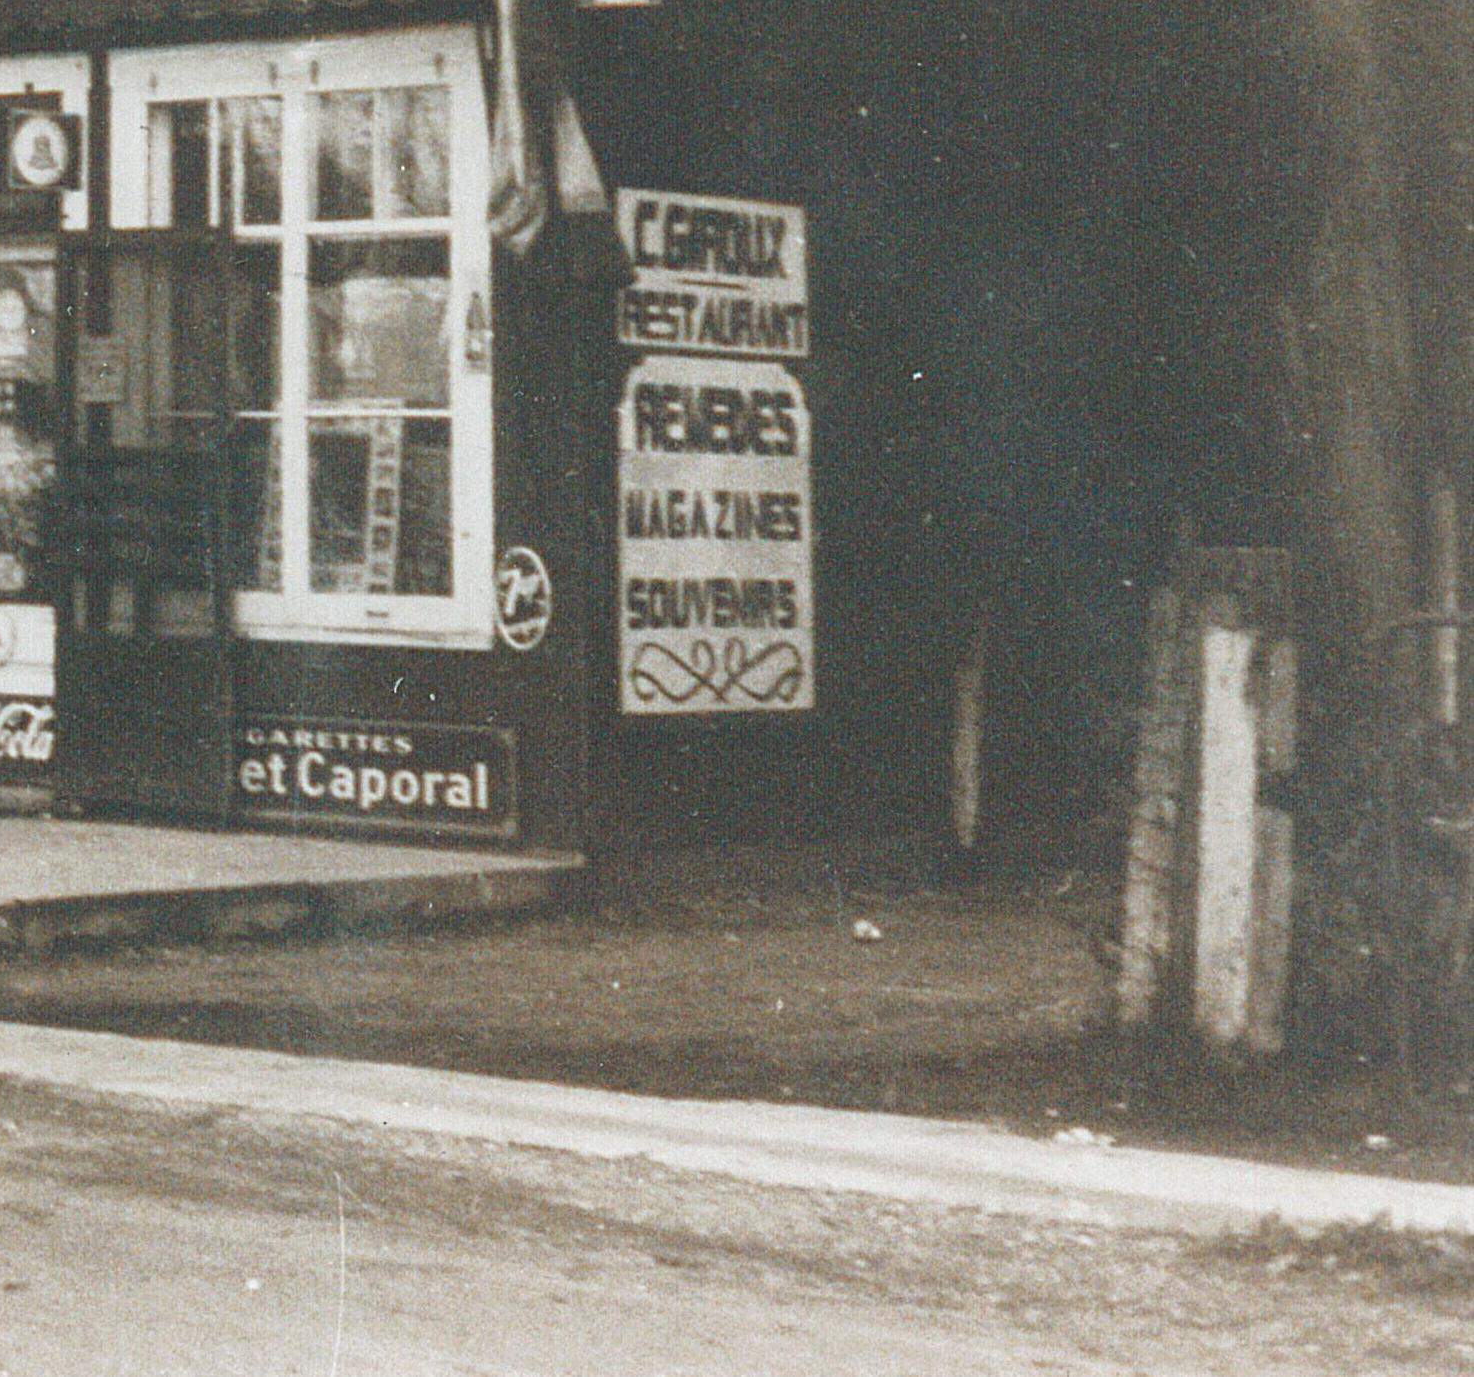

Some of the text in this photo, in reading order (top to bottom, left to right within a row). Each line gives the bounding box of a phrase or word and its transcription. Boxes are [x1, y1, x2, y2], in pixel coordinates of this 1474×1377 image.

[626, 489, 801, 542] MAGAZINES
[247, 728, 414, 754] GARETTES
[297, 751, 489, 810] Caporal
